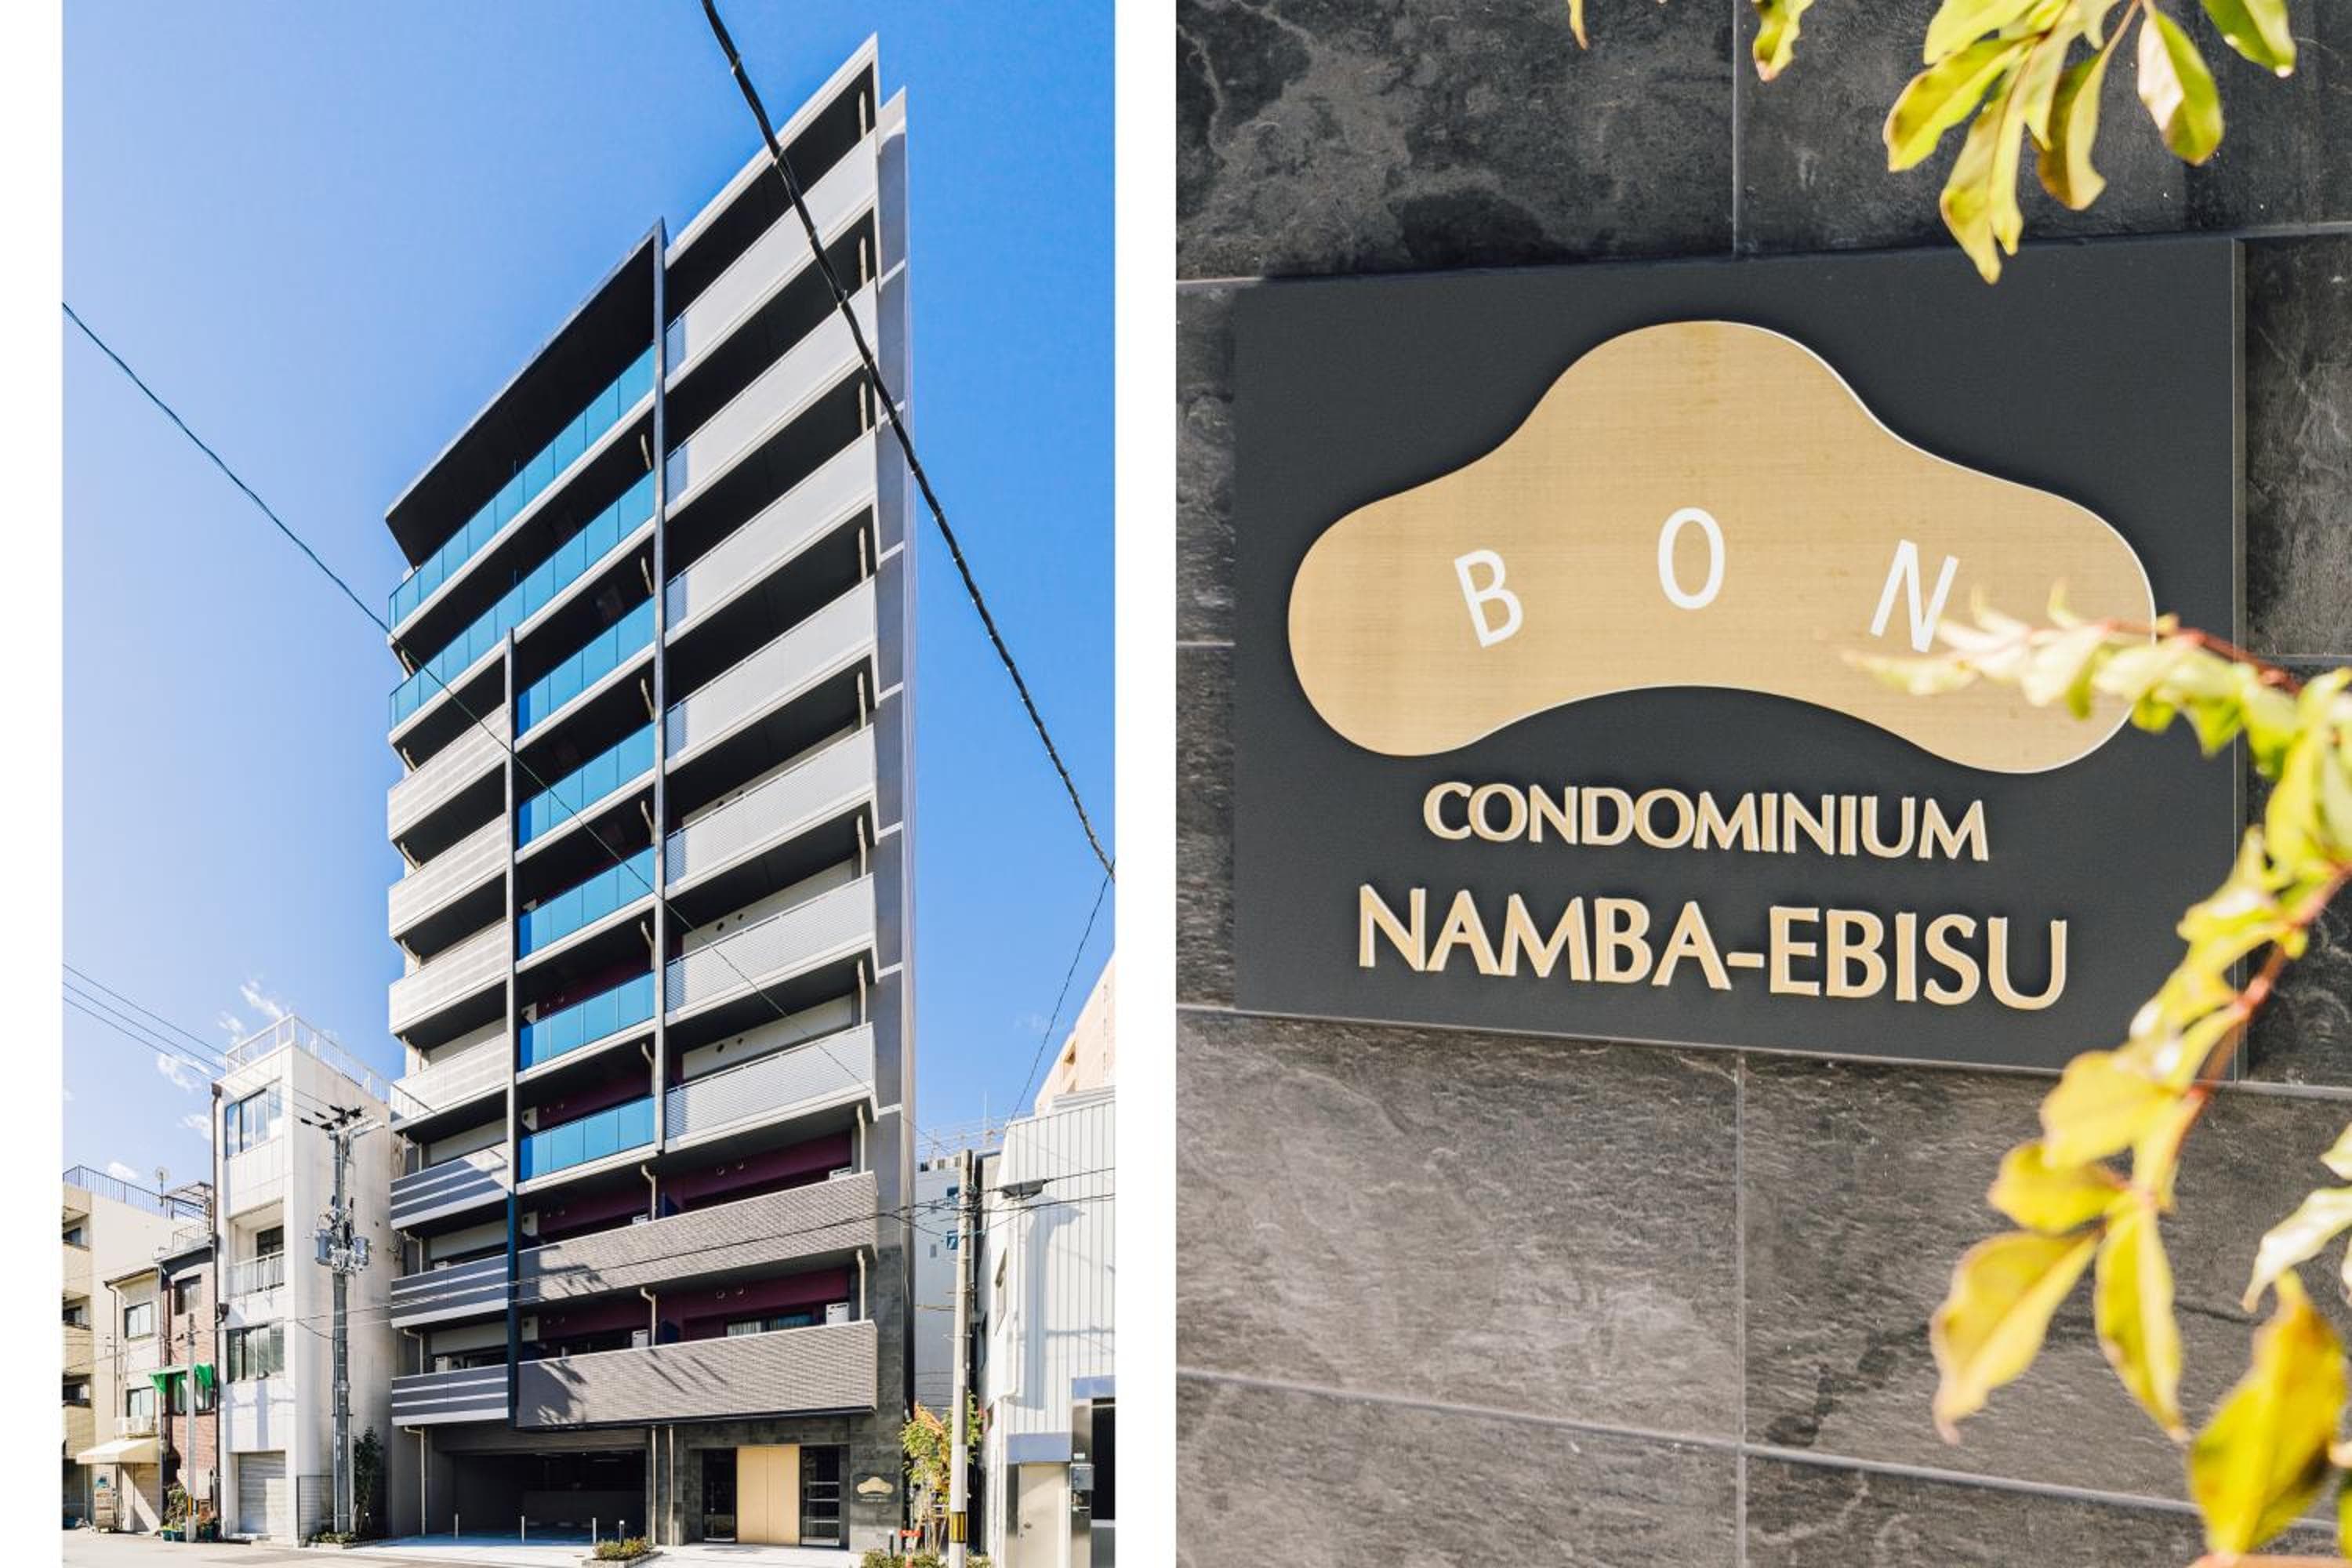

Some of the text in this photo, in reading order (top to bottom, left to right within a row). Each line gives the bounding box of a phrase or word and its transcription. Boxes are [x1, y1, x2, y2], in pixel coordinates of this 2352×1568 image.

[1454, 507, 1959, 653] BON
[1422, 781, 1990, 862] CONDOMINIUM
[1358, 883, 2068, 1011] NAMBA-EBISU
